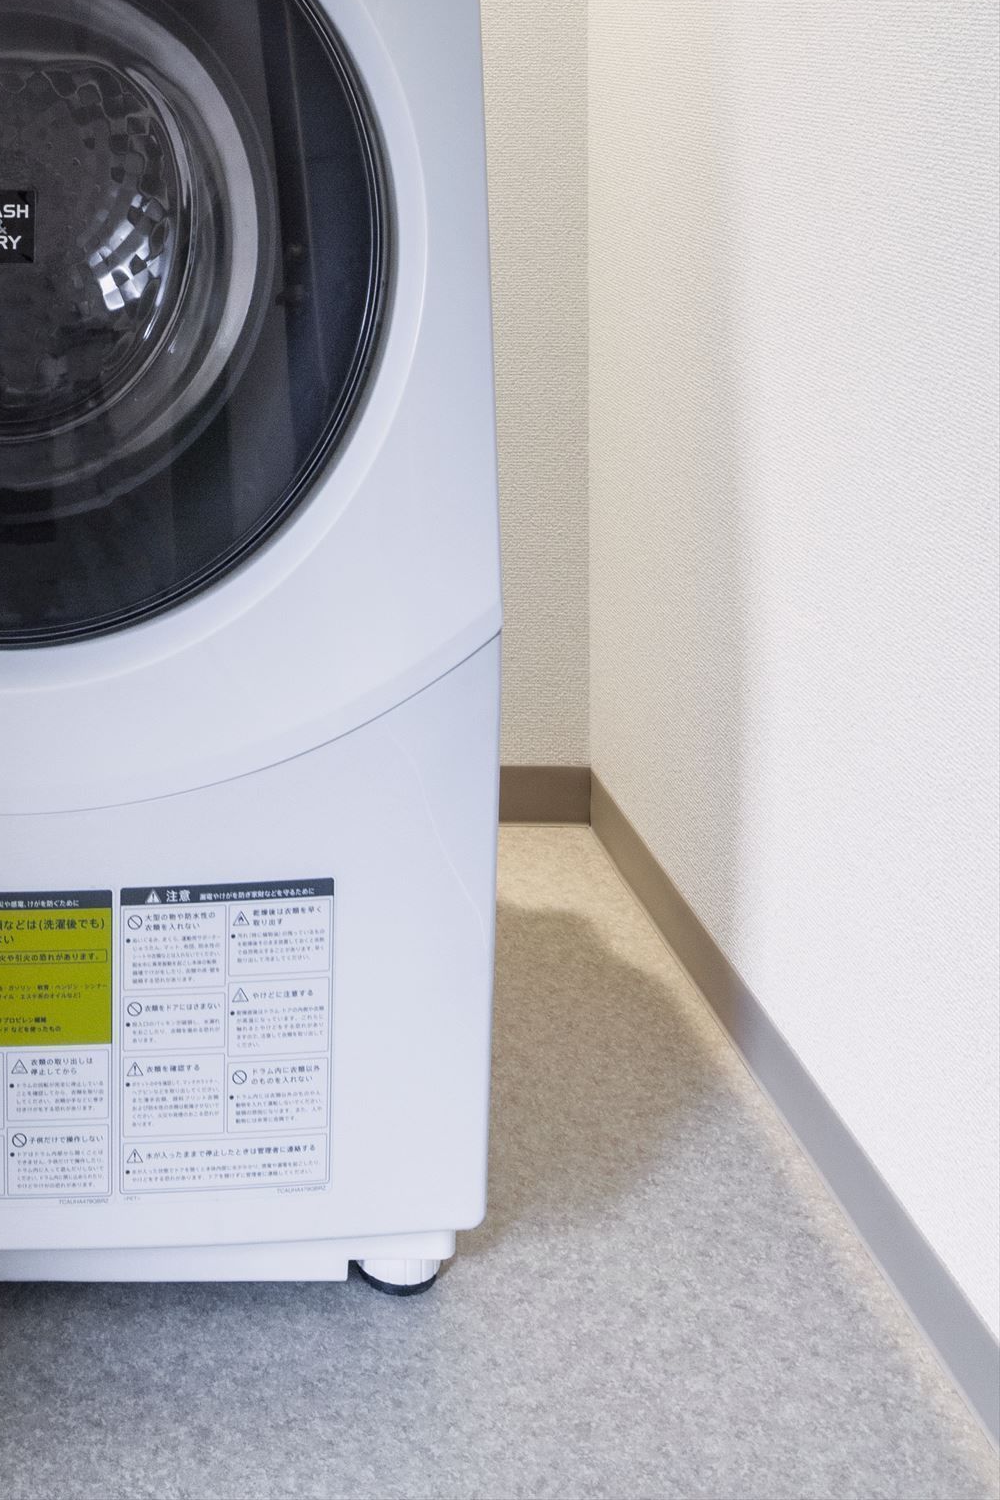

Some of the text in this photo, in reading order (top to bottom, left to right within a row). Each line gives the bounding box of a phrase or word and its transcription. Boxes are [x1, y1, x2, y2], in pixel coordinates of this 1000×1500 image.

[166, 890, 191, 902] 注意
[253, 918, 283, 926] 取り出す
[145, 922, 200, 932] 衣類を入れない
[253, 989, 314, 999] やけどに注意する
[145, 1002, 221, 1012] 衣類をドアにはさまない
[31, 1058, 93, 1066] 衣類の取り出しは
[31, 1068, 78, 1076] 停止してから
[251, 1076, 313, 1085] のものを入れない
[30, 1135, 104, 1144] 子供だけで操作しない
